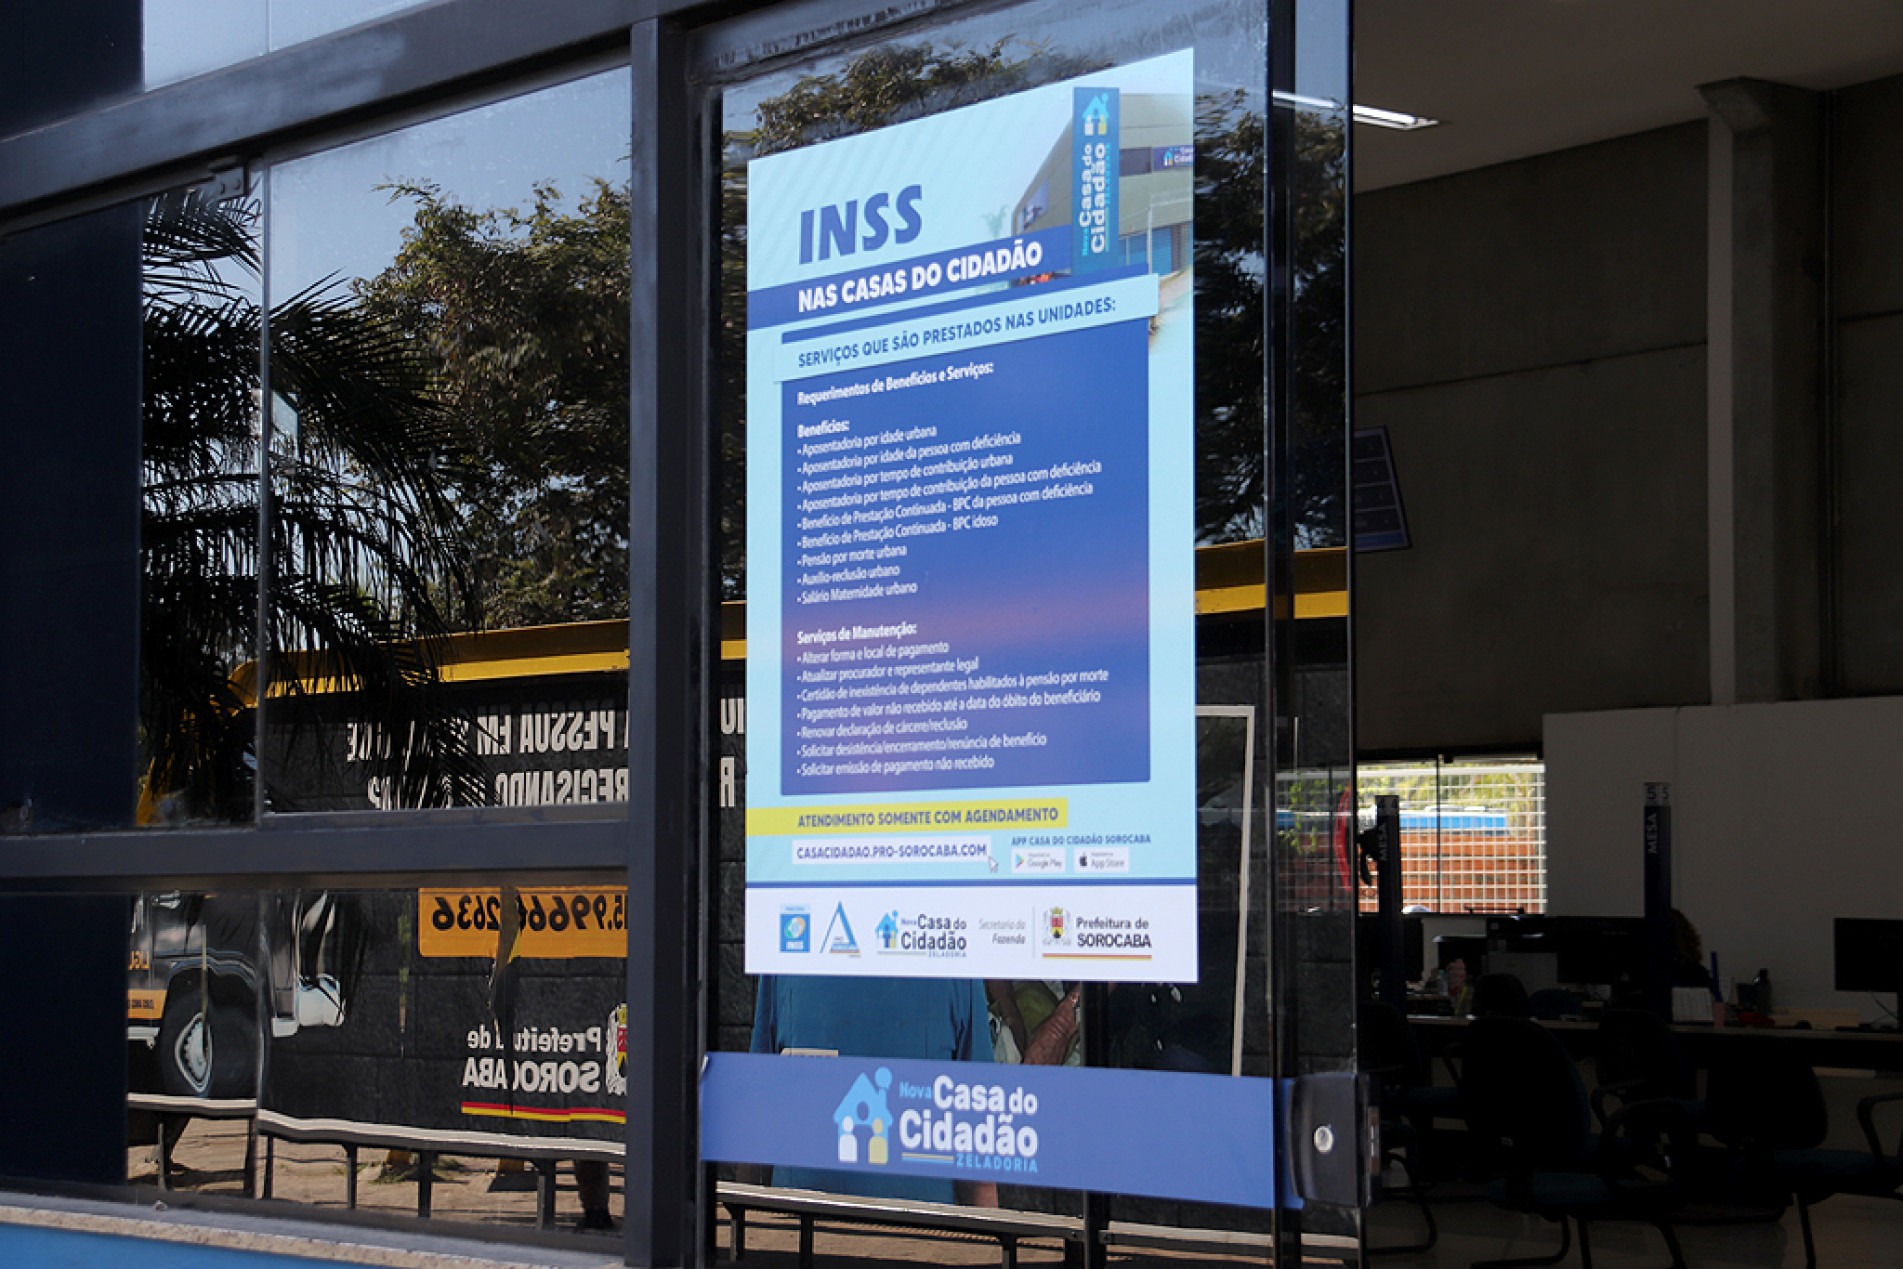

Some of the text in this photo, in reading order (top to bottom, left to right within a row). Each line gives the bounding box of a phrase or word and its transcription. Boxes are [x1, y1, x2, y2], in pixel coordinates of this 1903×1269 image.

[1082, 144, 1092, 166] do
[1079, 170, 1092, 228] Casa
[1091, 143, 1105, 254] Cidadão
[799, 184, 922, 265] INSS
[798, 284, 837, 313] NAS
[842, 269, 907, 304] CASAS
[912, 262, 942, 290] DO
[946, 239, 1043, 282] CIDADÃO
[798, 297, 1116, 368] SERVIÇOS QUE SÃO PRESTADOS NAS UNIDADES:
[797, 362, 994, 406] Requerimentos de Benefícios Serviços:
[797, 418, 850, 439] Benefícios:
[803, 426, 937, 457] Aposentadoria por idade urbana
[803, 432, 1021, 476] Aposentadoria por idade da pessoa com deficiência
[803, 454, 1013, 495] Aposentadoria por tempo de contribuição urbana
[803, 460, 1102, 513] Aposentadoria por tempo de contribuição da pessoa com deficiência
[803, 482, 1093, 530] Benefício de Prestação Continuada BPC da pessoa com deficiência
[803, 533, 840, 548] Benefício
[842, 530, 851, 544] de
[853, 526, 894, 543] Prestação
[896, 519, 946, 537] Continuada
[953, 516, 971, 531] BPC
[803, 545, 907, 567] Pensão por morte urbana
[869, 565, 900, 578] urbano
[803, 582, 918, 604] Salário Maternidade urbano
[797, 622, 917, 646] Serviços de Manutenção:
[803, 641, 948, 664] Alterar forma local de pagamento
[803, 656, 979, 682] Atualizar procurador representante legal
[803, 669, 1108, 702] Certidão de inexistência de dependentes habilitados pensão por morte
[801, 690, 1100, 722] Pagamento de valor não recebido até data do óbito do beneficiário
[801, 726, 835, 738] Renovar
[836, 722, 881, 738] declaração
[883, 721, 894, 734] de
[801, 744, 834, 758] Solicitar
[989, 735, 1001, 749] de
[1003, 733, 1047, 747] benefício
[801, 756, 995, 777] Solicitar emissão de pagamento não recebido
[1647, 786, 1656, 799] 5
[797, 807, 1058, 828] ATENDIMENTO SOMENTE COM AGENDAMENTO
[1011, 832, 1151, 846] APP CASA DO CIDADÃO SOROCABA
[1647, 813, 1658, 854] MESA
[797, 844, 987, 859] CASACIDADAO.PRO-SOROCABA.COM
[917, 914, 967, 930] Casa do
[1076, 916, 1149, 930] Prefeitura de
[901, 931, 967, 950] Cidadão
[992, 933, 1026, 945] Fazenda
[1077, 933, 1152, 948] SOROCABA
[900, 1074, 1038, 1116] Nova Casa do
[900, 1108, 1038, 1158] Cidadão
[956, 1152, 1038, 1174] ZELADORIA
